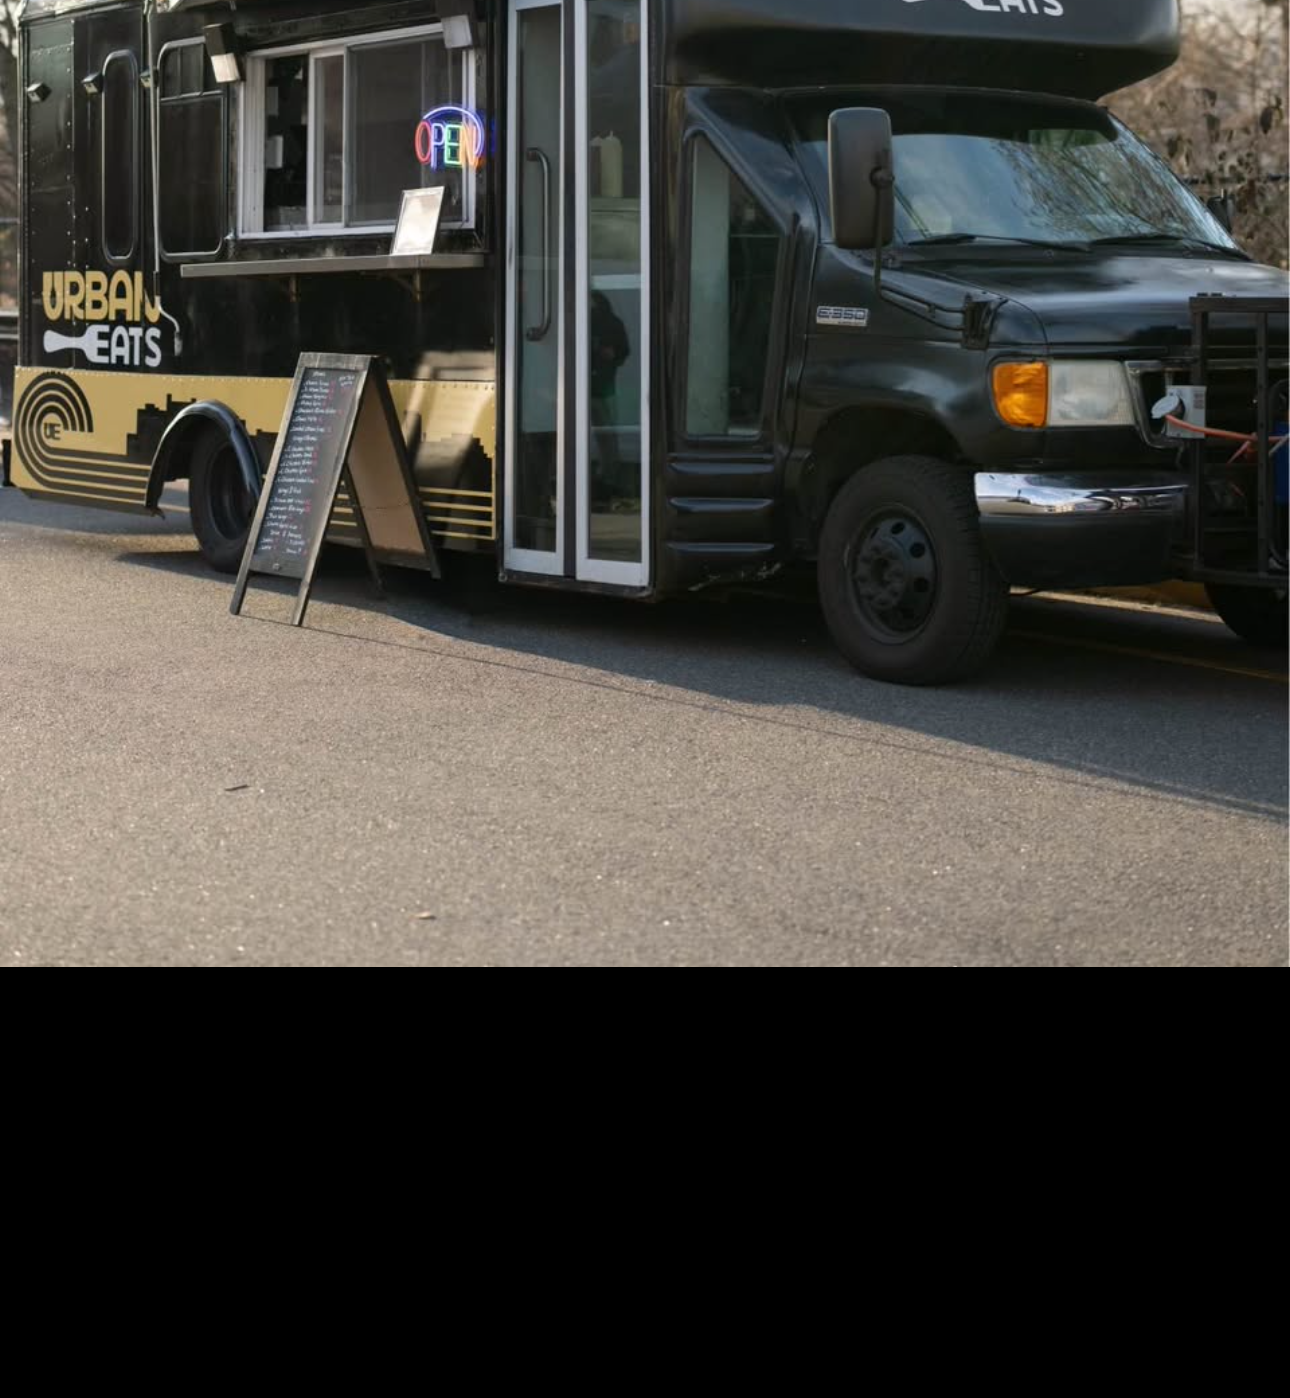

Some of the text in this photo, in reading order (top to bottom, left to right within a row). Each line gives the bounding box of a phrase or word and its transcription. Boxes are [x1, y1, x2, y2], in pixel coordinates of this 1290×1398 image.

[415, 120, 477, 169] OPEN
[42, 269, 161, 323] URBAN
[85, 324, 162, 368] EATS
[43, 422, 61, 440] UE
